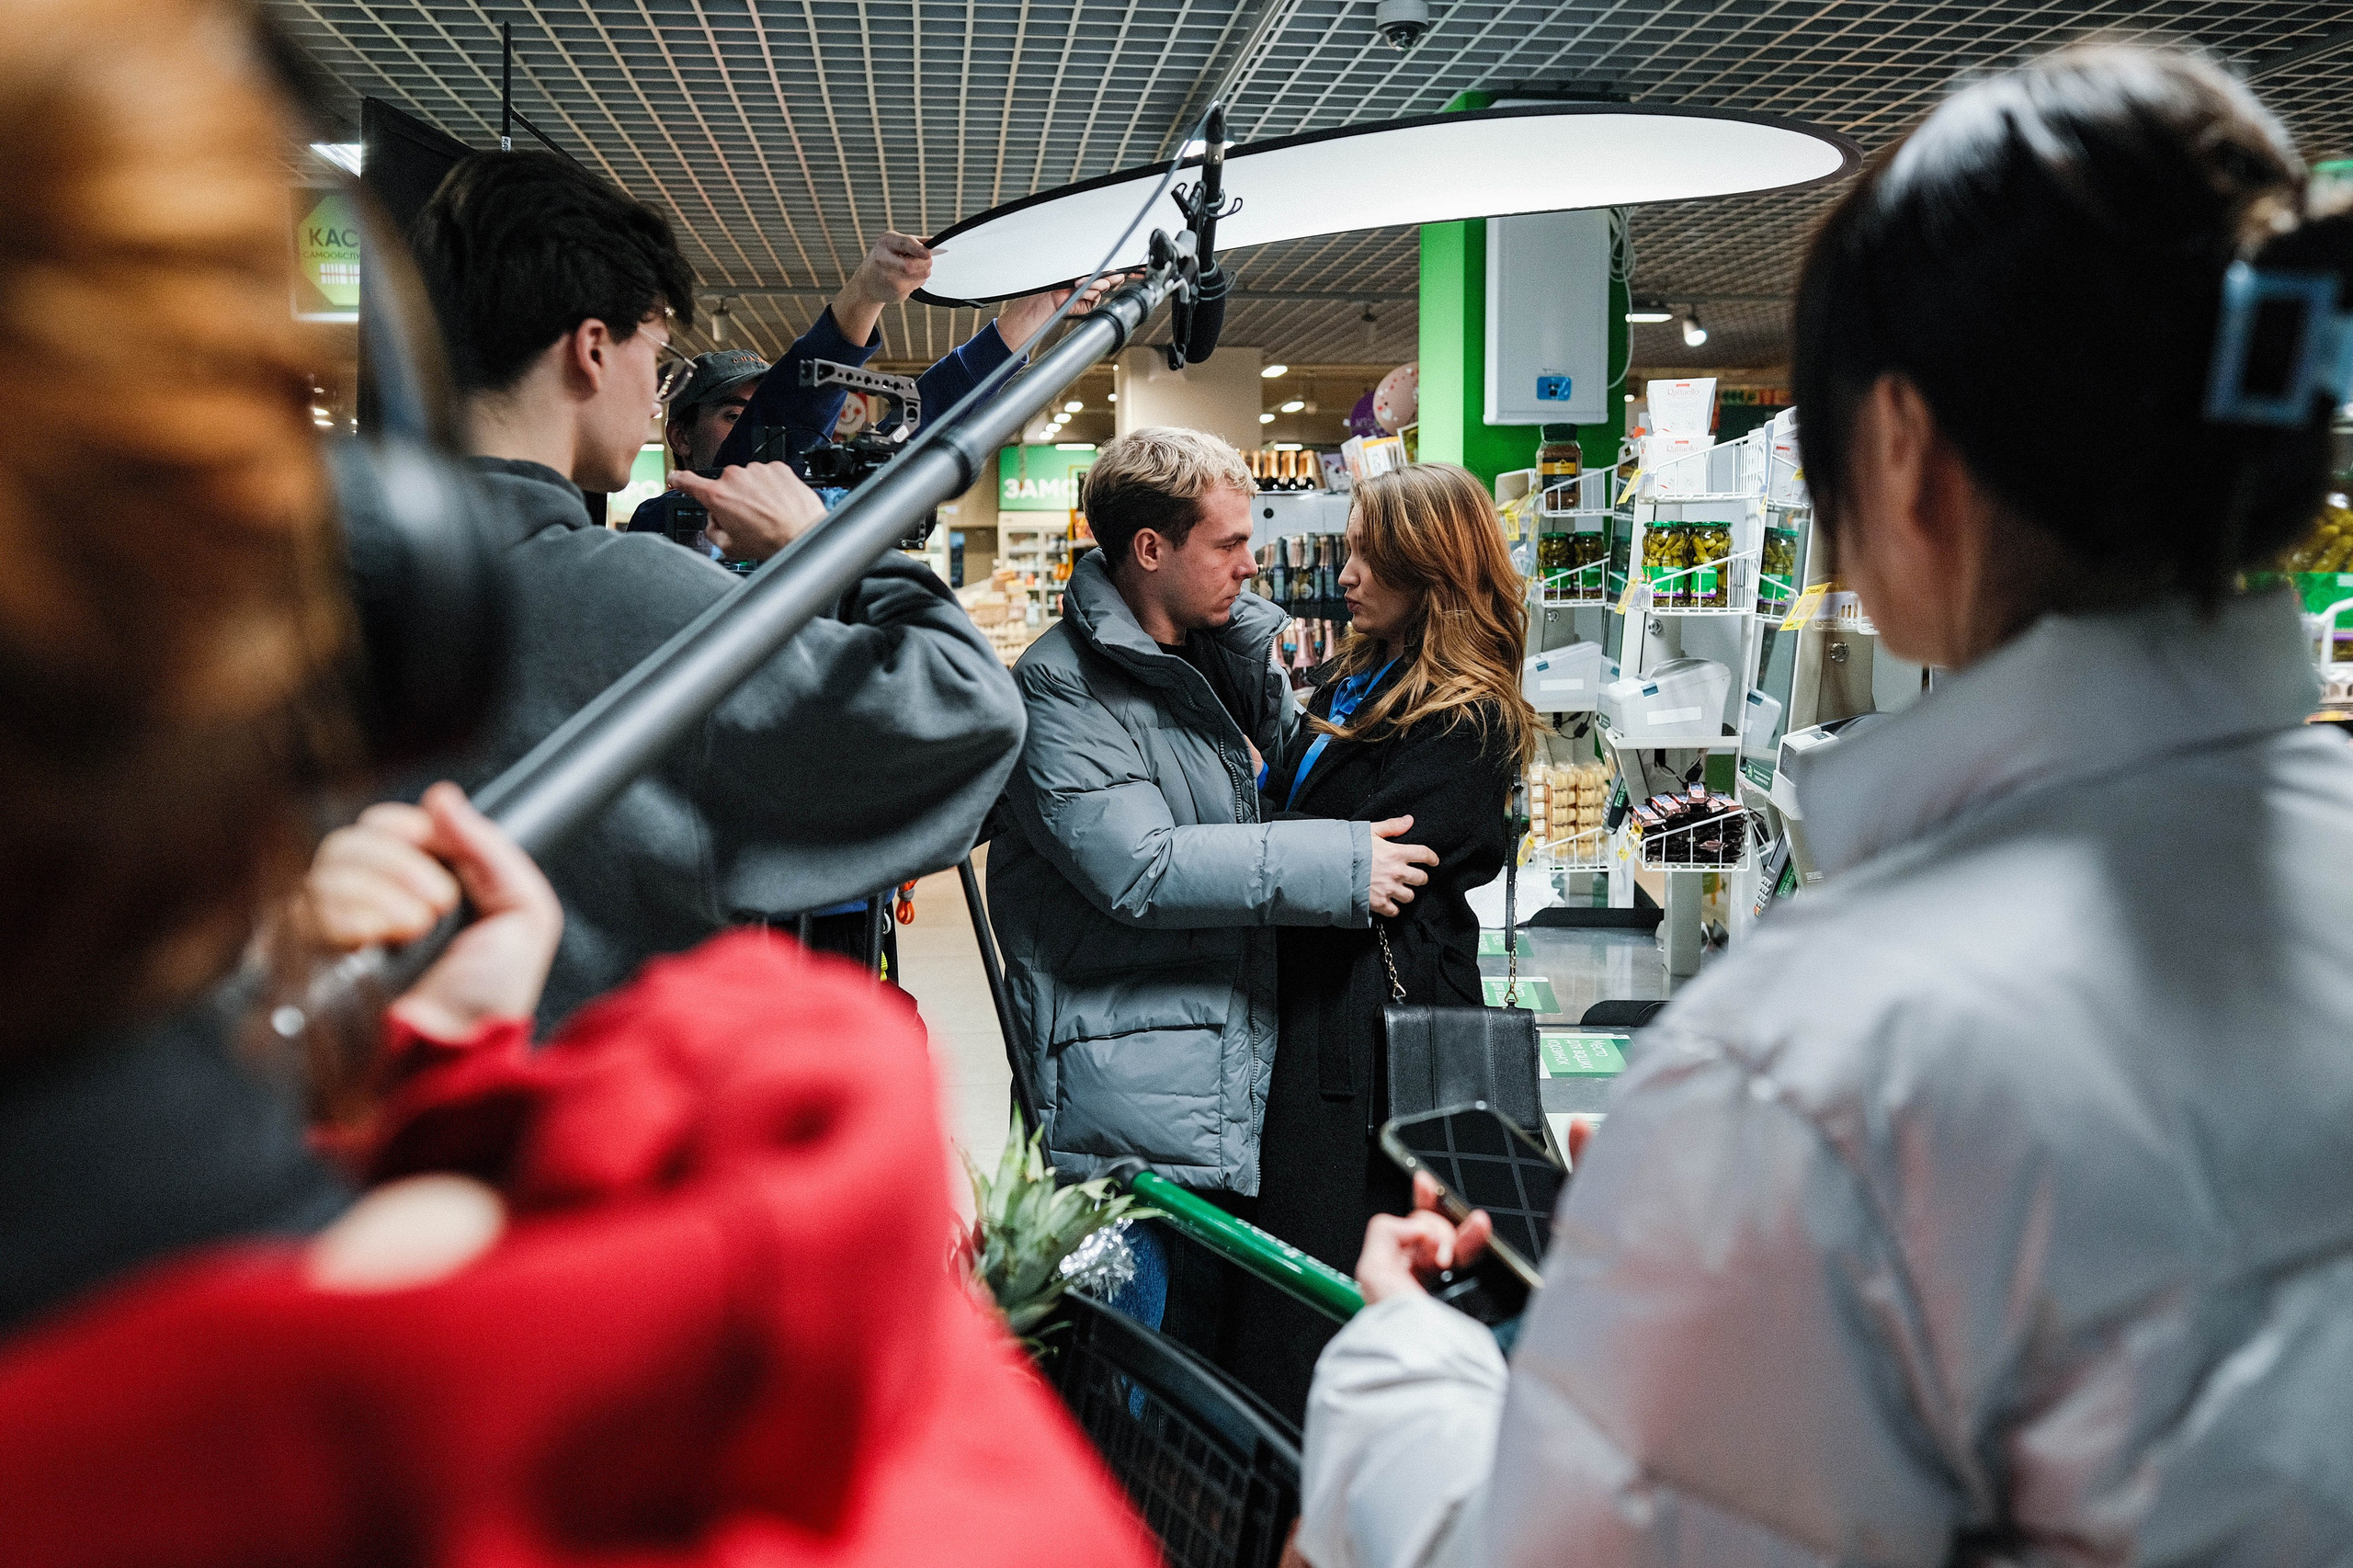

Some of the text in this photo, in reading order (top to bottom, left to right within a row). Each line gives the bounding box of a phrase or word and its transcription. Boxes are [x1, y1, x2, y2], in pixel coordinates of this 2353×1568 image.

[308, 227, 359, 248] КАС
[1667, 388, 1699, 396] Raffaello
[1666, 444, 1699, 452] Raffaello
[1545, 1039, 1570, 1066] корзинок
[1563, 1039, 1594, 1070] для ваших
[1587, 1039, 1609, 1058] Место
